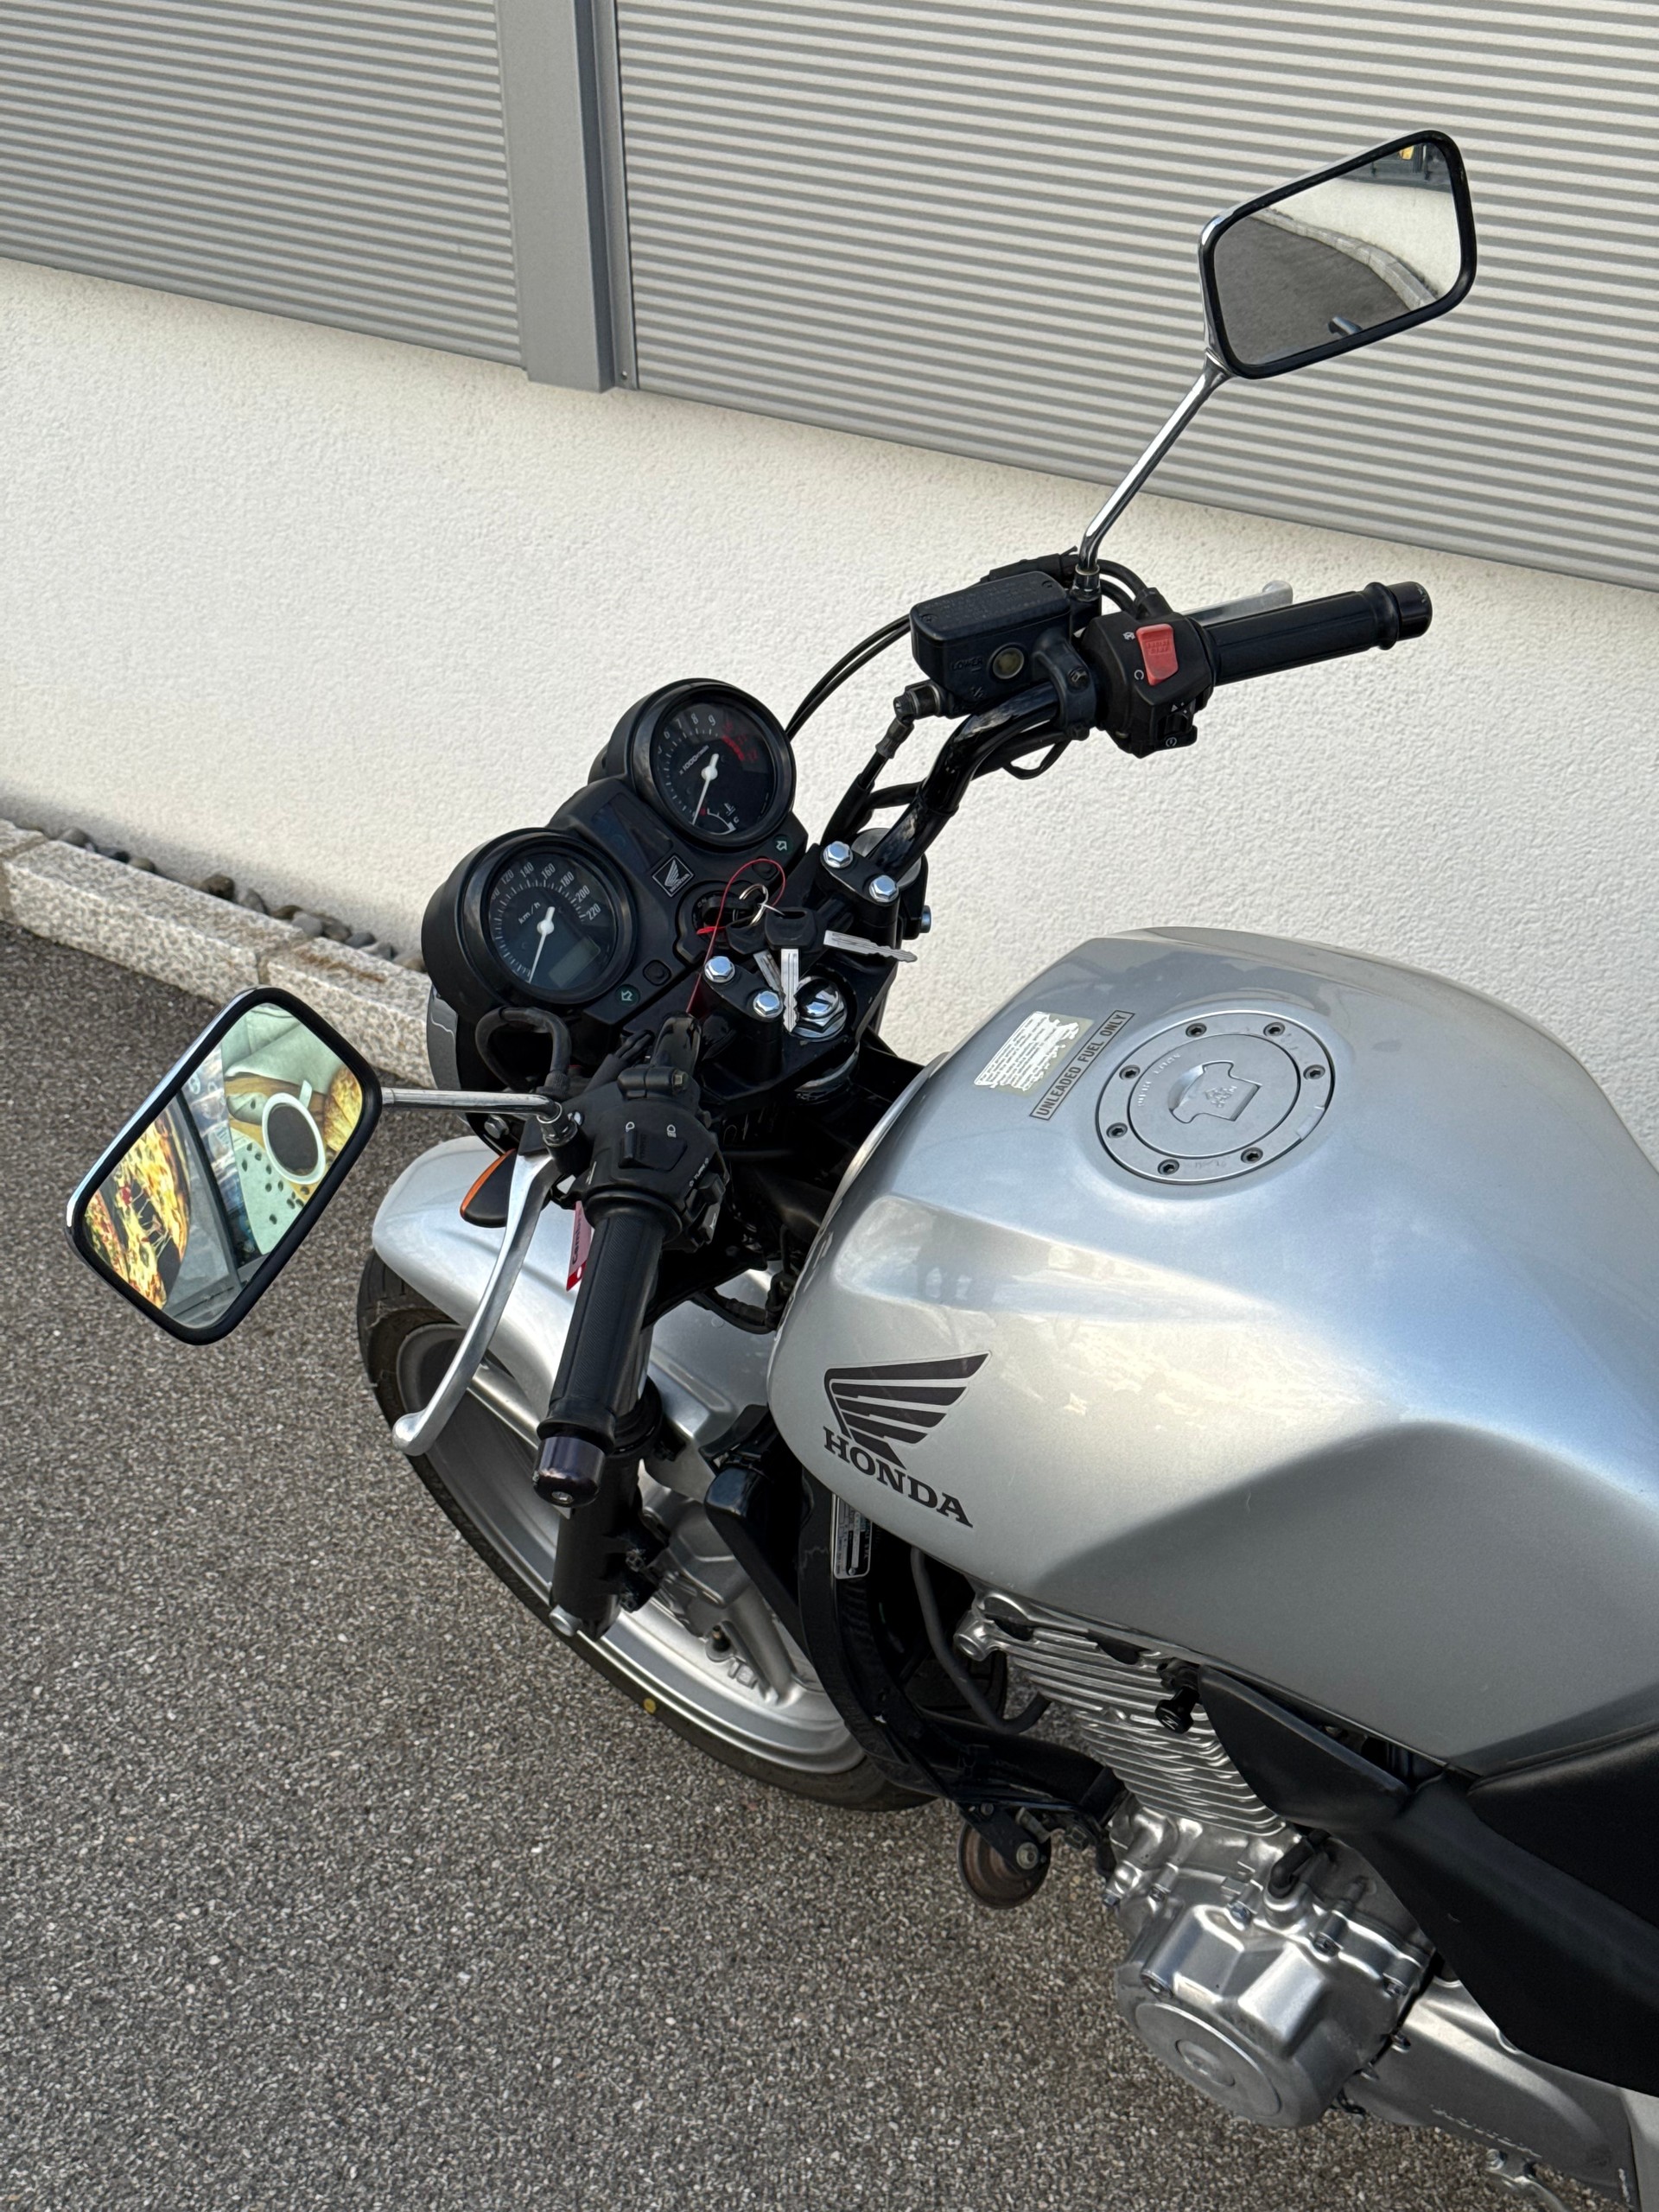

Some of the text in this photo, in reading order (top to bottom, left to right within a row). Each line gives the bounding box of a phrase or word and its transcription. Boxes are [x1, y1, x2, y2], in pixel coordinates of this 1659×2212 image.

[675, 718, 683, 729] 7
[691, 713, 699, 725] 8
[709, 715, 716, 727] 9
[501, 869, 514, 885] 120
[519, 861, 534, 878] 140
[541, 862, 556, 880] 160
[560, 871, 575, 887] 180
[575, 884, 590, 903] 200
[518, 901, 541, 925] km/h
[586, 903, 601, 920] 220
[1036, 1013, 1127, 1116] UNLEADED FUEL ONLY
[823, 1426, 974, 1529] HONDA
